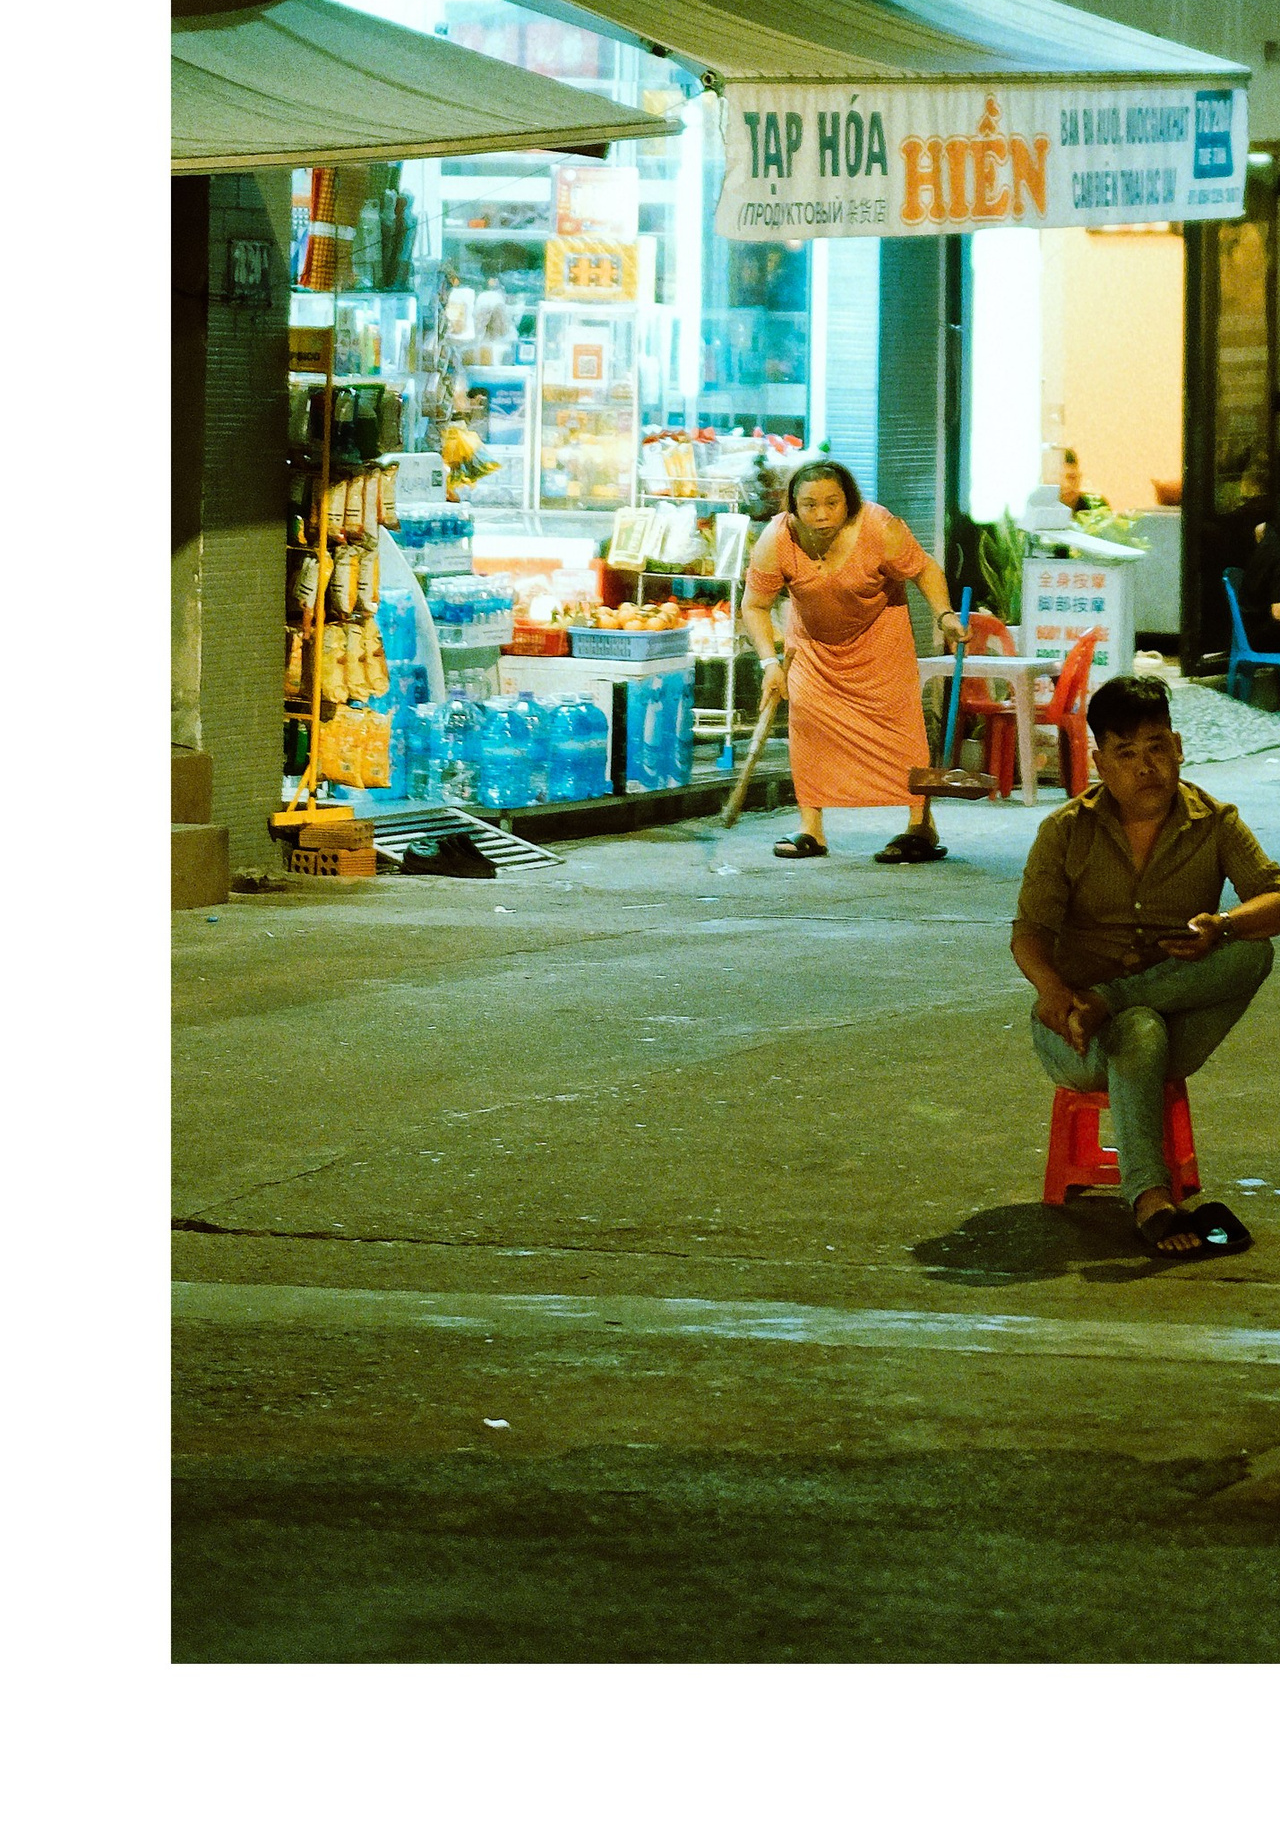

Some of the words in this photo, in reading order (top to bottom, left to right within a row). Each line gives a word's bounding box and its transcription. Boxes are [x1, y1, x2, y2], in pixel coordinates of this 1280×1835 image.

[743, 109, 803, 195] TẠP
[818, 93, 888, 178] HÓA
[900, 93, 1053, 226] HIỀN
